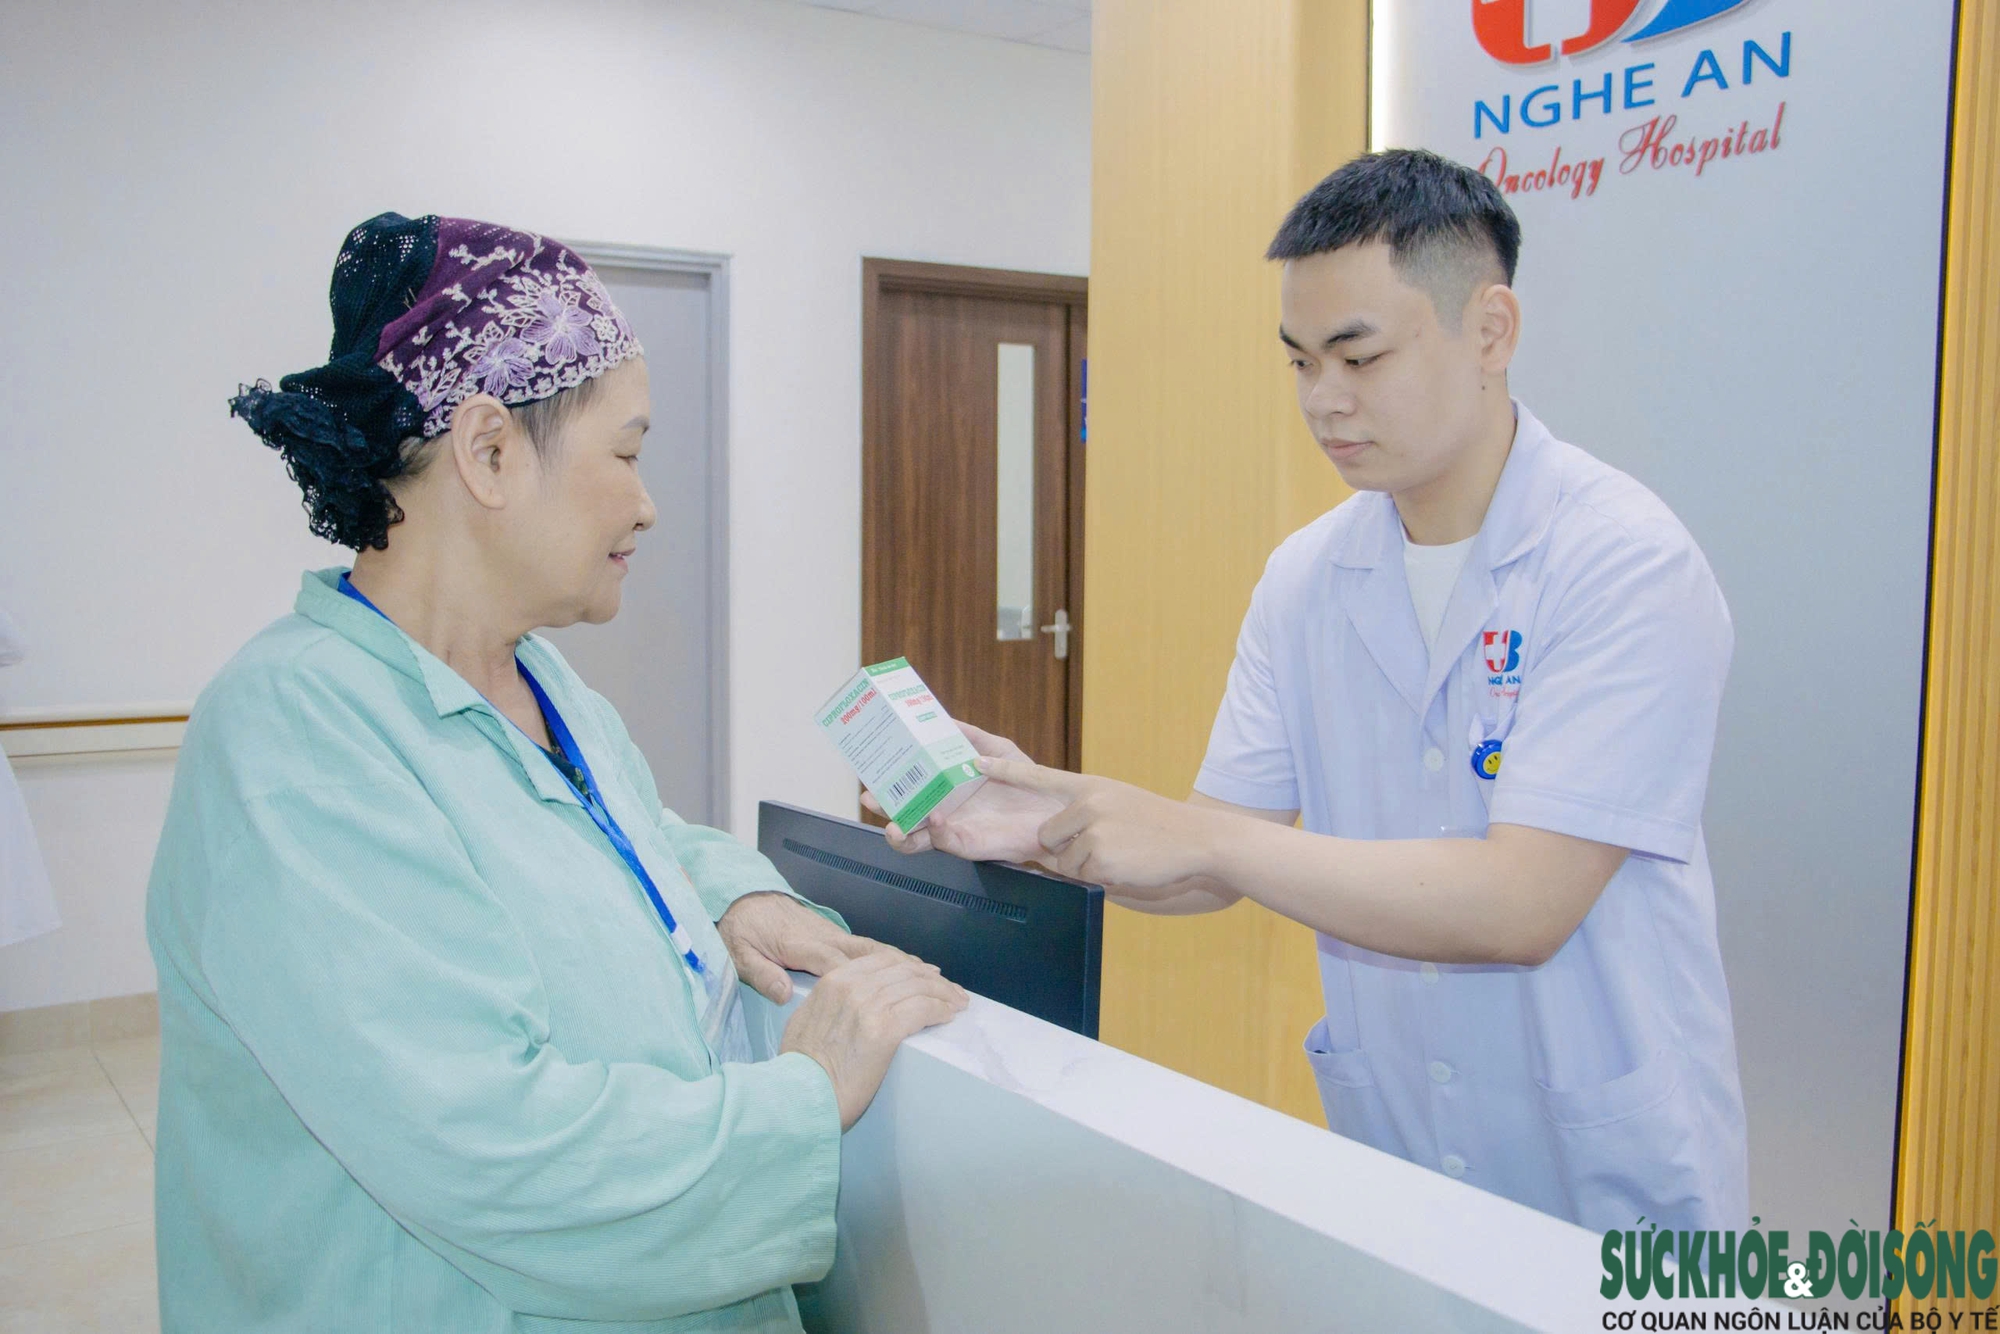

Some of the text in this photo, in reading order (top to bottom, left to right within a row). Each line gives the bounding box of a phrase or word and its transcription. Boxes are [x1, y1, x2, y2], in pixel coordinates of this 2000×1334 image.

[1474, 31, 1791, 139] NGHE AN
[1478, 101, 1786, 200] Oncology Hospital
